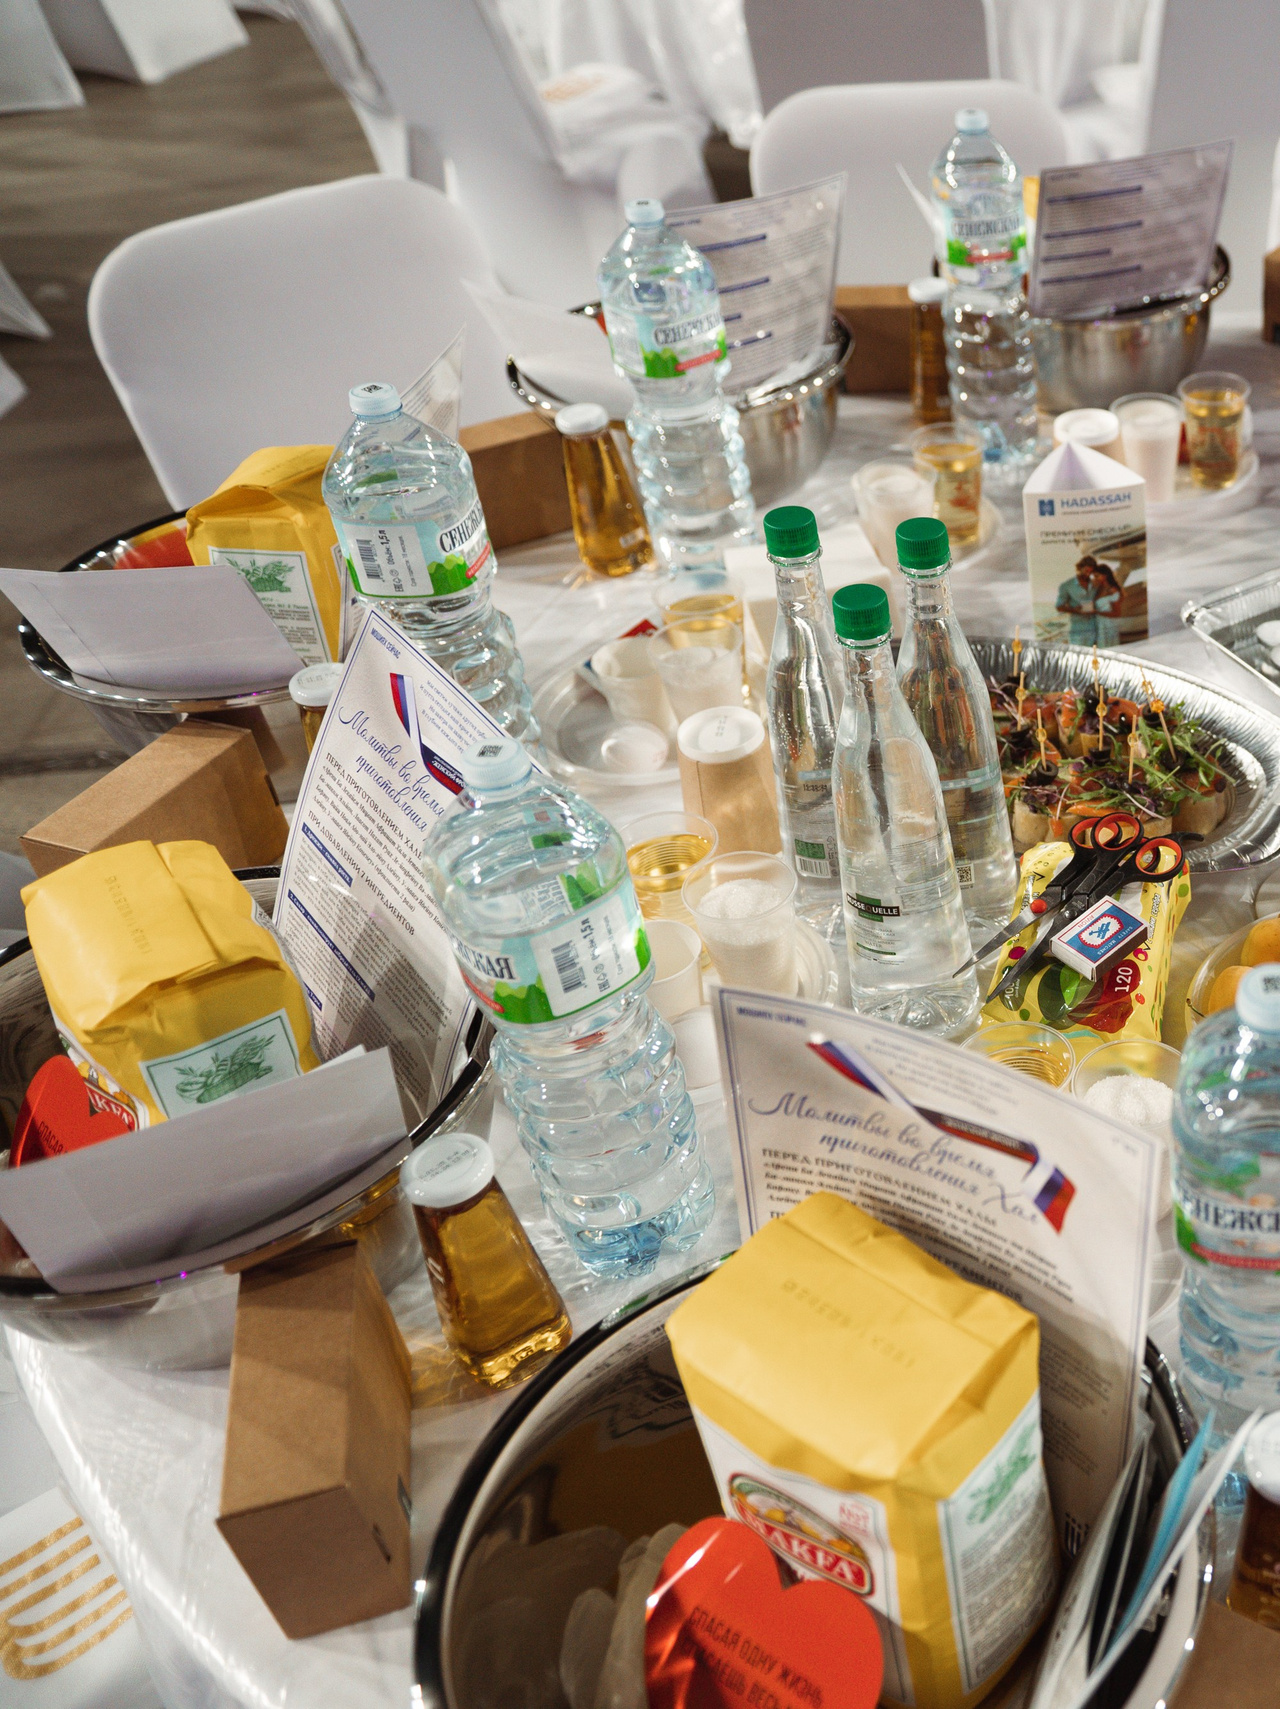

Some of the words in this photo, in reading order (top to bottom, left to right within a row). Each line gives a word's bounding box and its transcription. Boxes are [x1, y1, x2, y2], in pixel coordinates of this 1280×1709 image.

[1061, 493, 1132, 509] HADASSAH
[325, 751, 346, 779] ПЕРЕД
[345, 773, 404, 841] ПРИГОТОВЛЕНИЕМ
[338, 707, 400, 770] Молитвы
[399, 753, 416, 786] во
[409, 769, 445, 819] время
[356, 755, 427, 832] приготовления
[306, 809, 322, 828] ПРИ
[319, 825, 362, 874] ДОБАВЛЕНИИ
[363, 875, 416, 936] ИНГРЕДИЕНТОВ
[1118, 926, 1133, 940] SAFETY
[1115, 966, 1133, 993] 120
[748, 1091, 890, 1137] Молитвы
[898, 1115, 927, 1147] во
